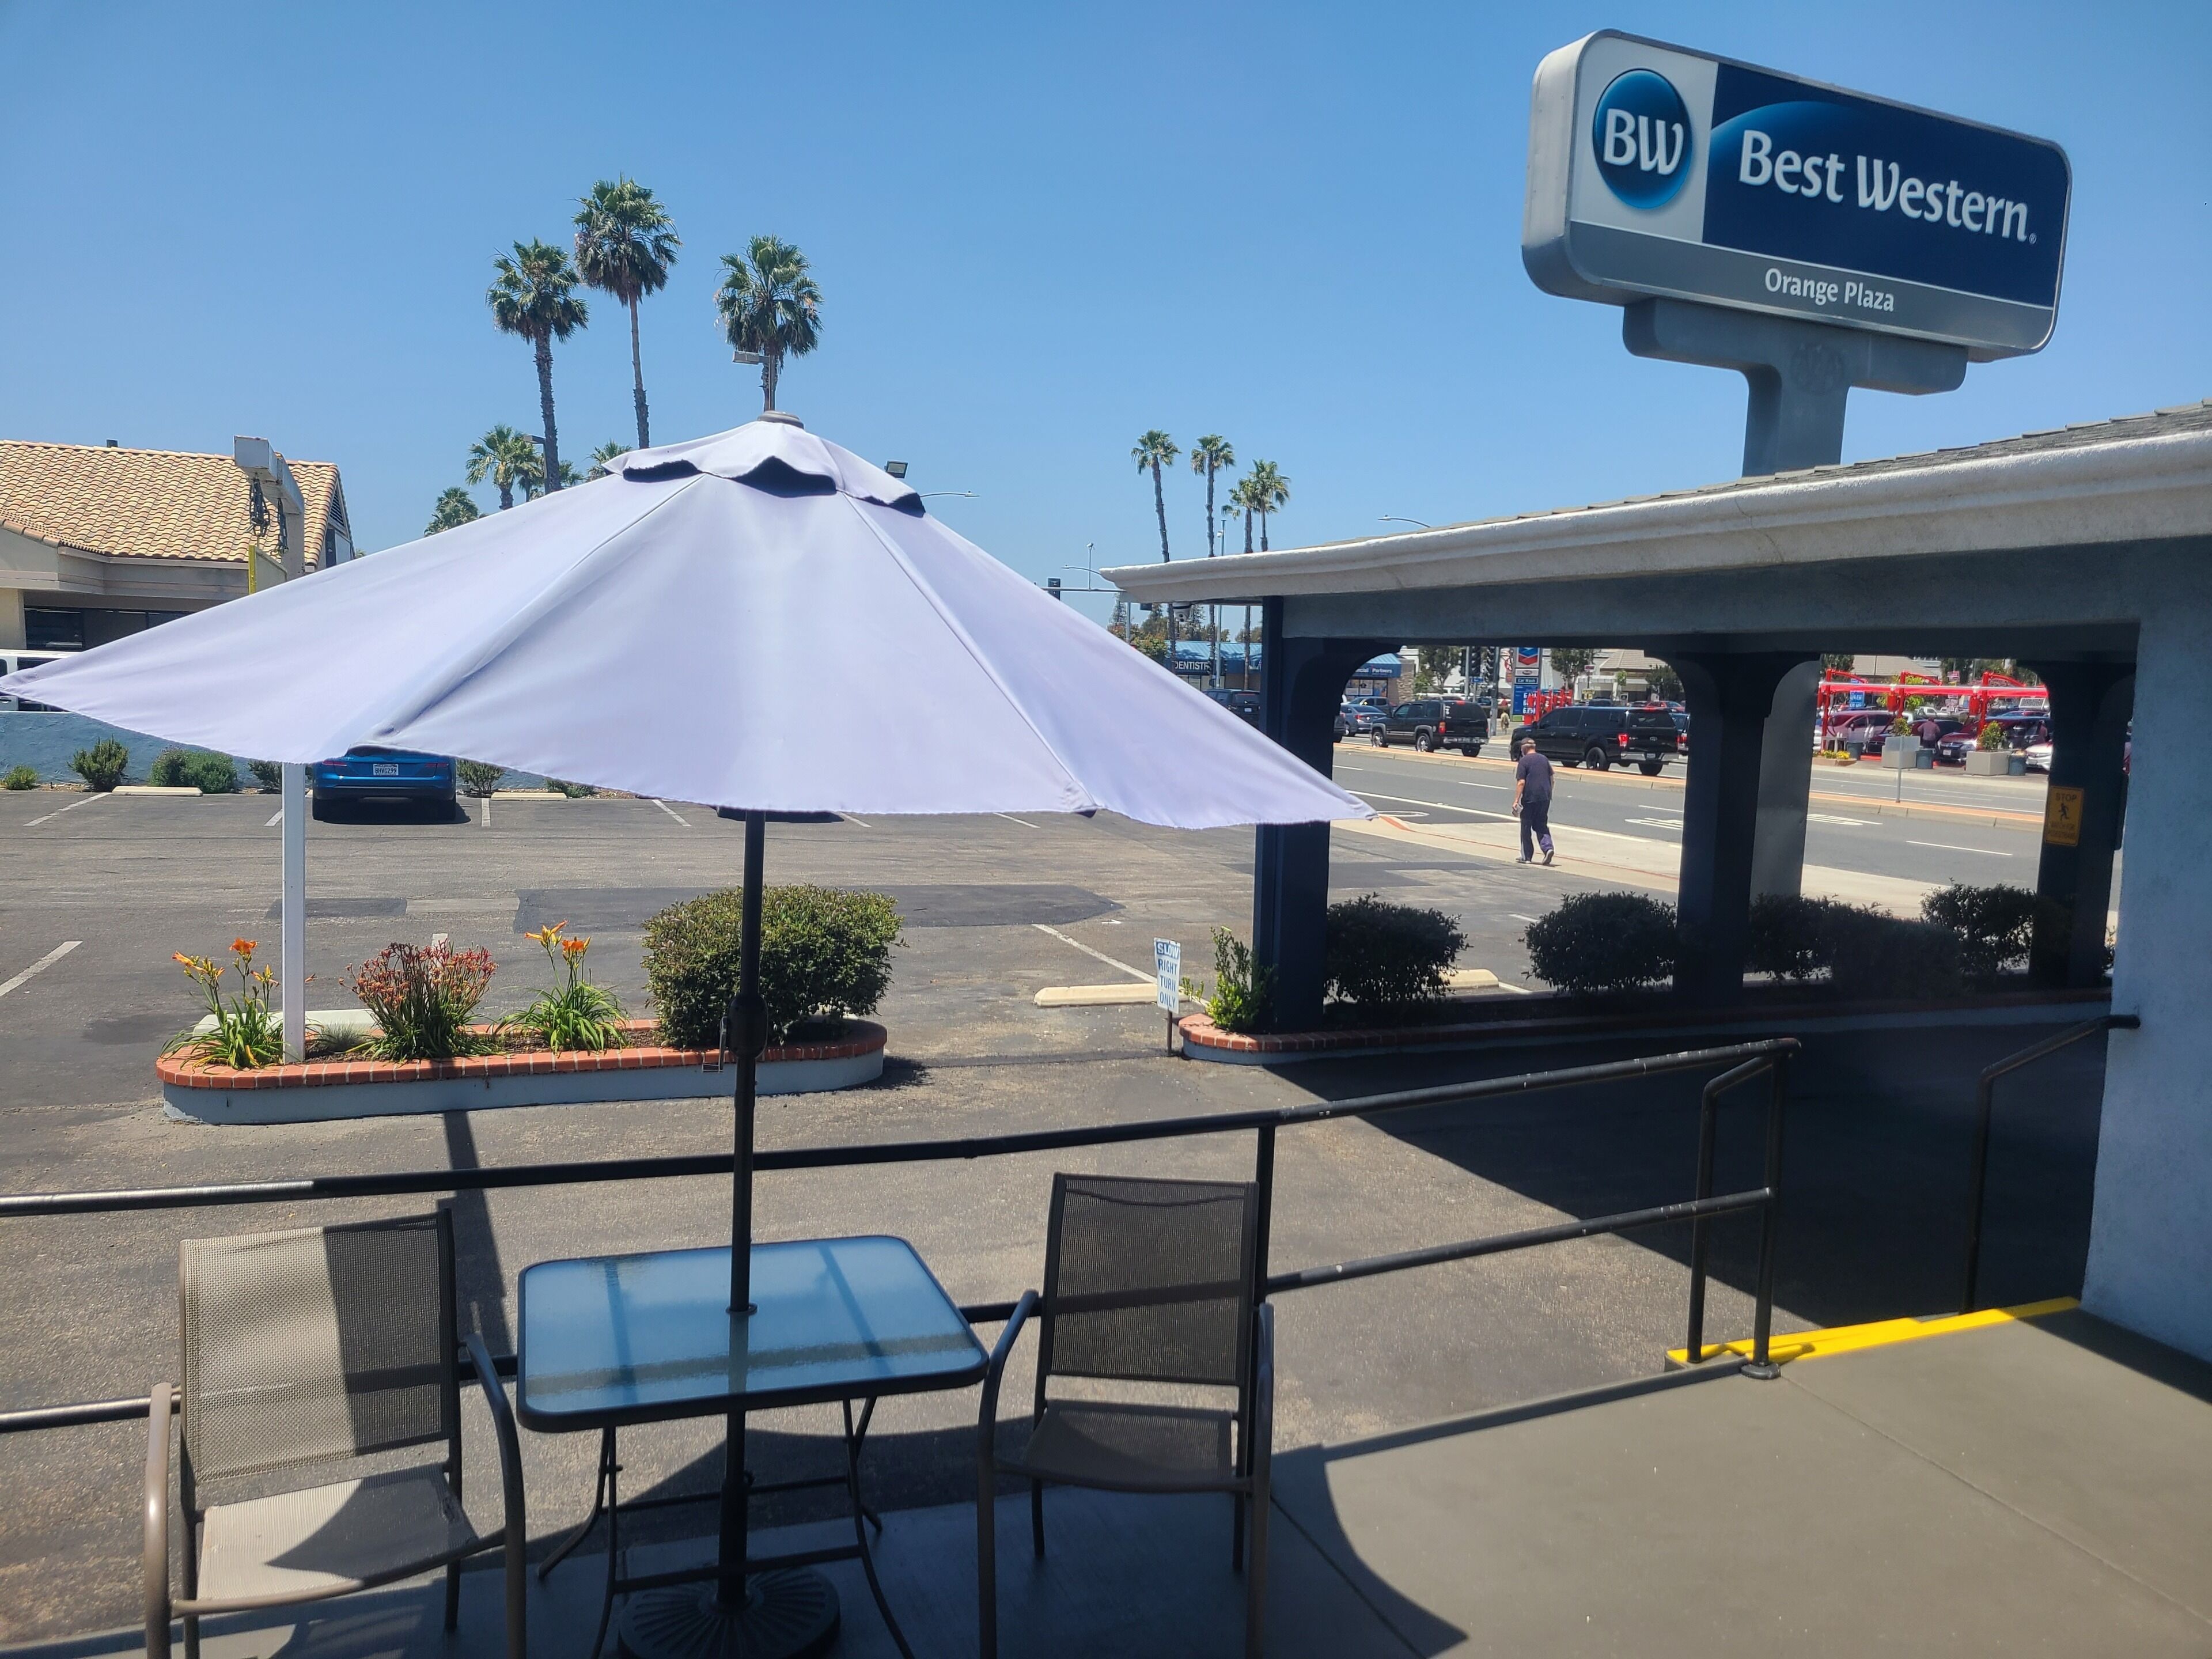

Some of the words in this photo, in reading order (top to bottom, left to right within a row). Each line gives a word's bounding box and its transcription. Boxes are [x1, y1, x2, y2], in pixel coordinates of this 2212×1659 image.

[1603, 108, 1684, 176] BW
[1739, 129, 1845, 203] Best
[1857, 154, 2028, 243] Western
[1765, 268, 1839, 306] Orange
[1844, 281, 1895, 312] Plaza
[1175, 661, 1209, 671] DENTISTR
[2055, 793, 2077, 802] STOP
[1157, 942, 1179, 959] SLOW
[1158, 958, 1177, 975] RIGHT
[1160, 975, 1176, 992] TURN
[1160, 993, 1176, 1008] ONLY
